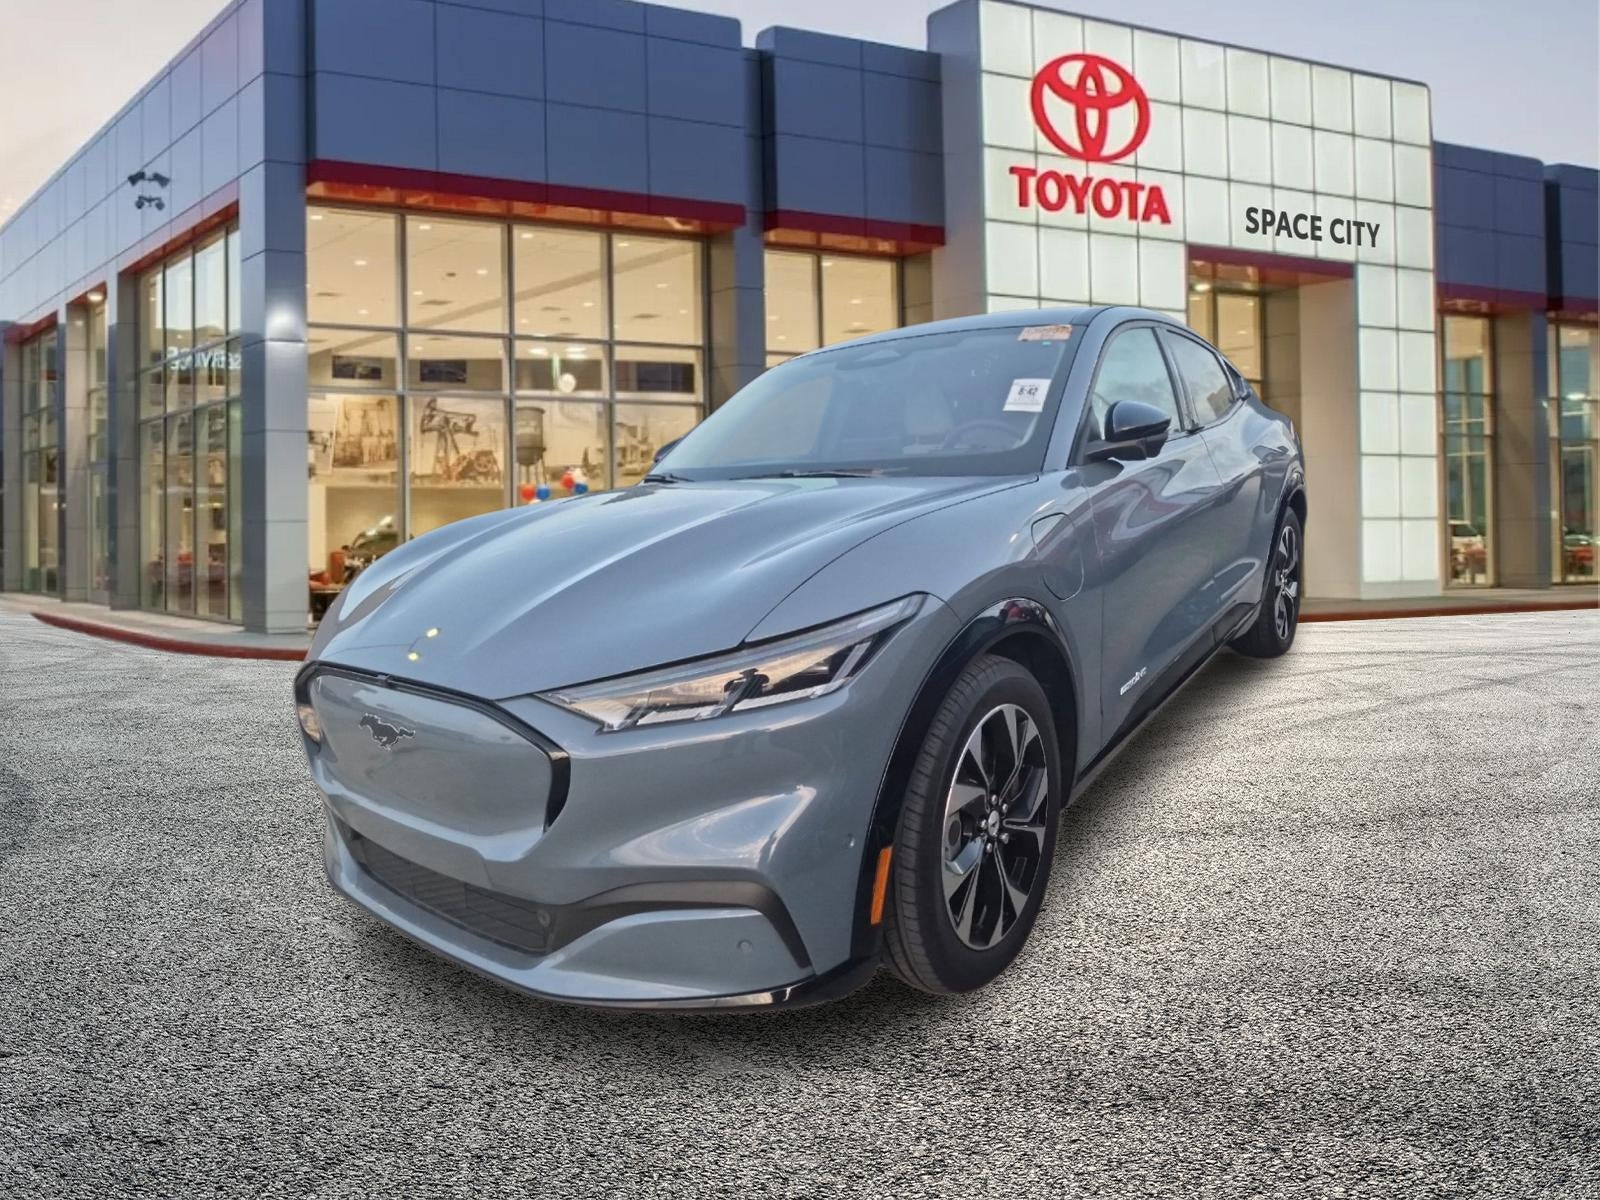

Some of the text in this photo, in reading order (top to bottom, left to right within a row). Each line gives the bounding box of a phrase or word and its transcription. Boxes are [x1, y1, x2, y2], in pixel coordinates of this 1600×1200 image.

[1009, 166, 1171, 224] TOYOTA
[1245, 206, 1380, 247] SPACE CITY
